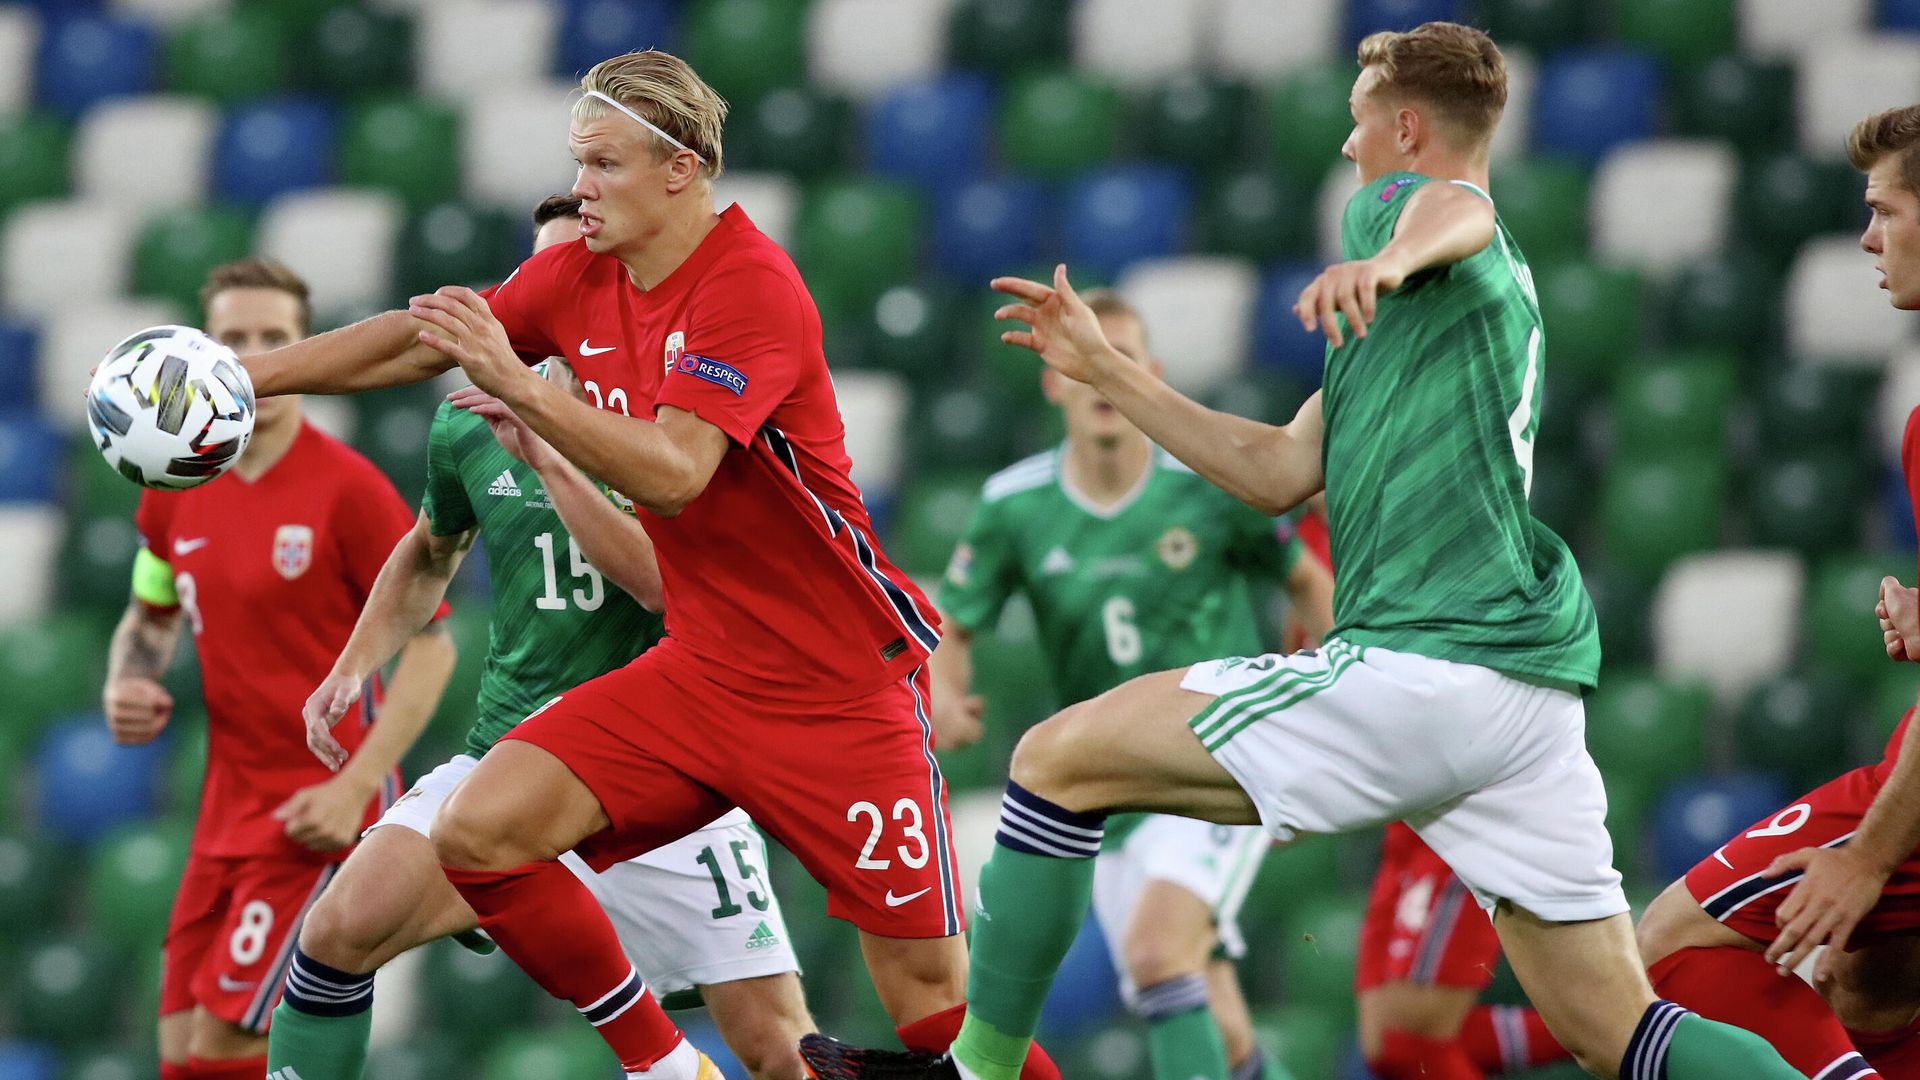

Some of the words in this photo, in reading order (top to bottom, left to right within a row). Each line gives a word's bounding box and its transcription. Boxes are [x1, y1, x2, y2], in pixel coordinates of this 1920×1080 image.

[699, 362, 746, 390] RESPECT
[487, 487, 522, 497] adidas
[534, 532, 605, 612] 15
[1103, 595, 1143, 667] 6
[847, 797, 930, 871] 23
[1744, 801, 1812, 840] 9
[696, 840, 770, 919] 15
[228, 899, 275, 968] 8
